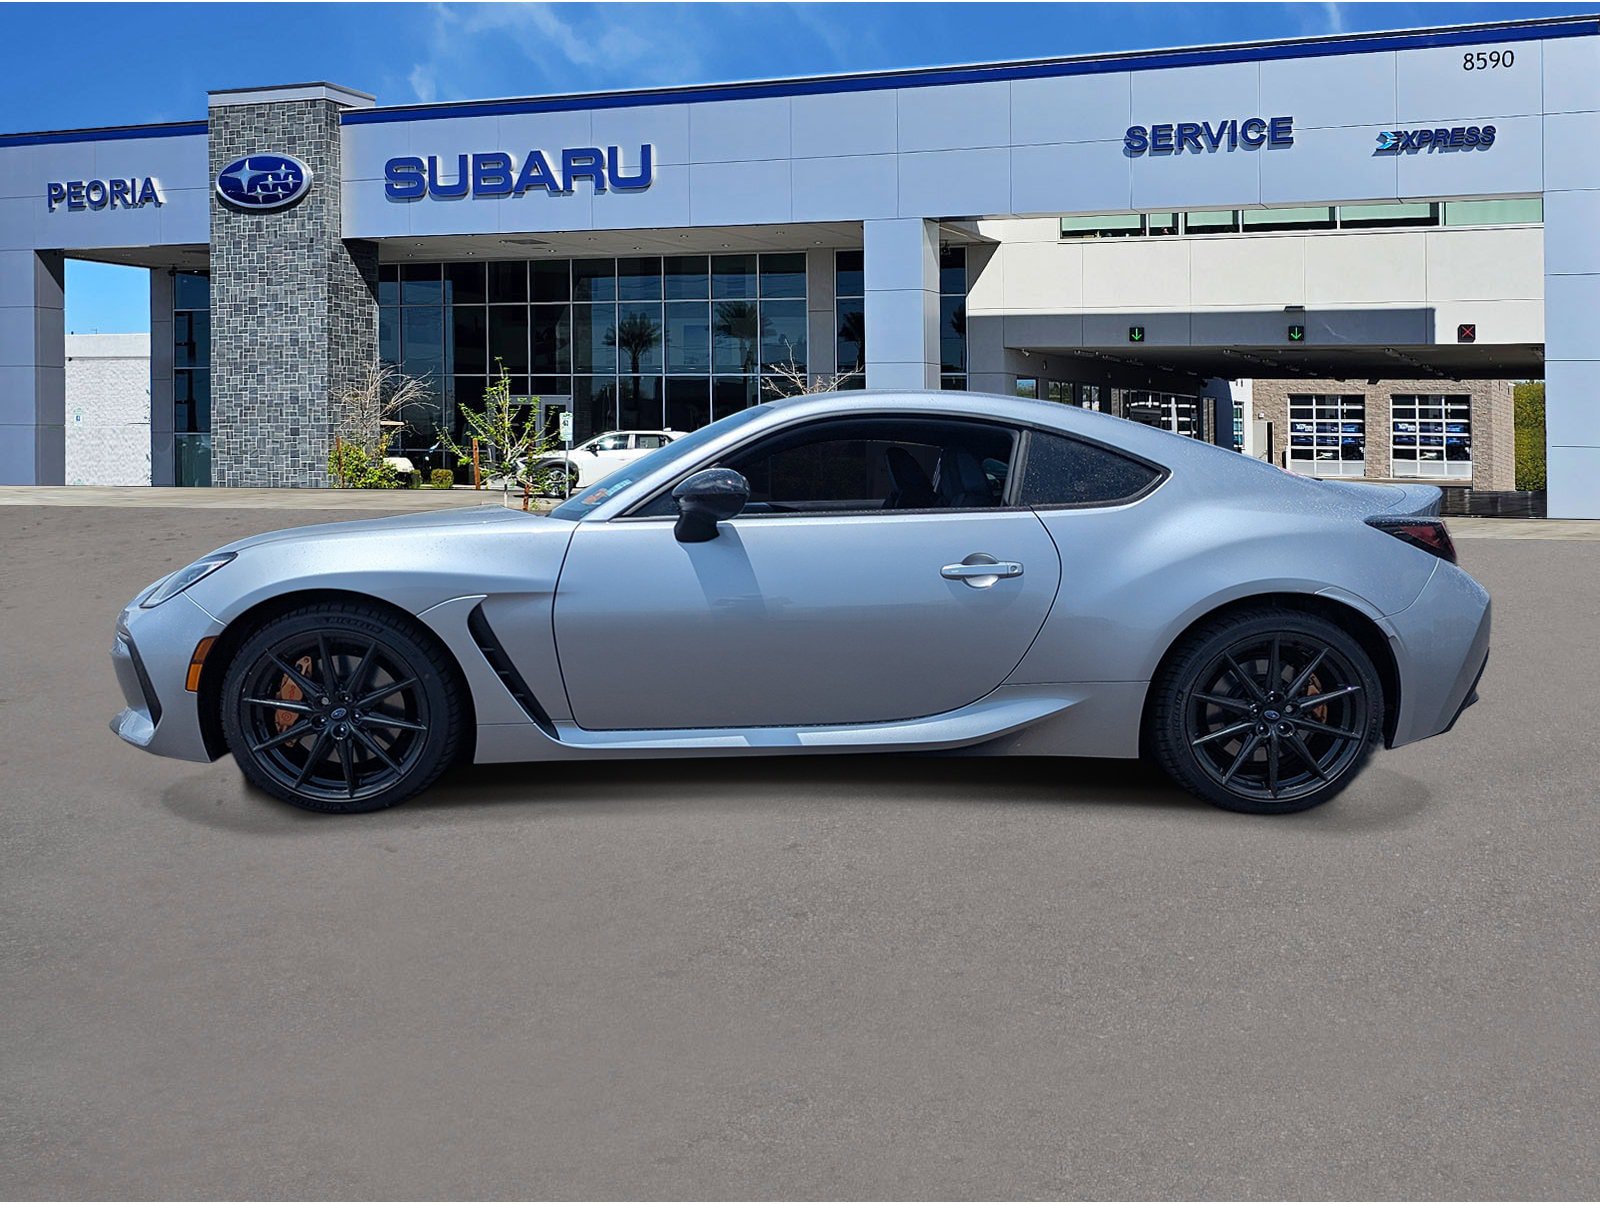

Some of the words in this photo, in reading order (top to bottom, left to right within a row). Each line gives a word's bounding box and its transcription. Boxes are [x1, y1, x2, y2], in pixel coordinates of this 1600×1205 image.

[1463, 50, 1514, 71] 8590
[1124, 116, 1294, 154] SERVICE
[1375, 125, 1497, 152] EXPRESS
[384, 144, 652, 199] SUBARU
[47, 177, 162, 211] PEORIA
